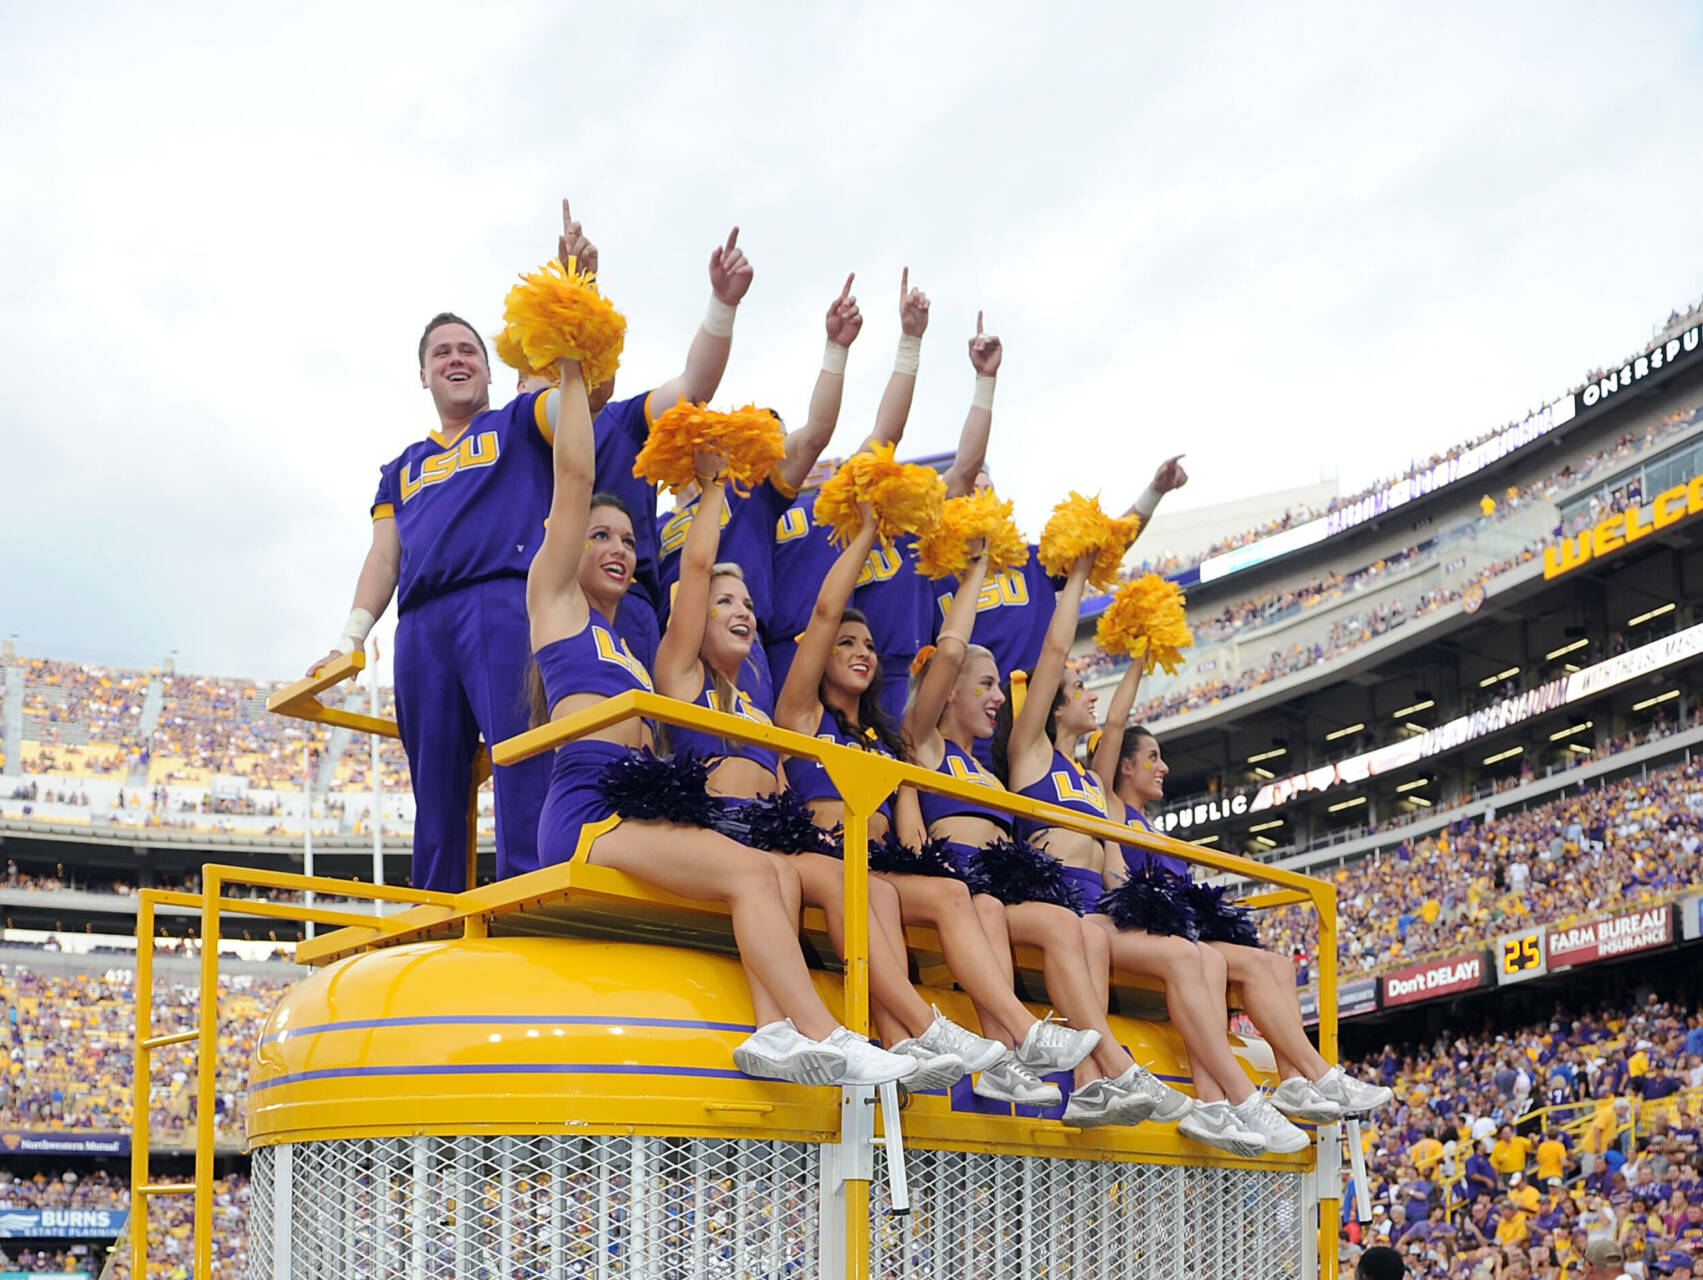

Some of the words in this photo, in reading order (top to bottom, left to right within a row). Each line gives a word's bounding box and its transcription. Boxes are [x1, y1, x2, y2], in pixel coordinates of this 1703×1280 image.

[401, 431, 500, 505] LSU
[1550, 926, 1596, 952] FARM
[1597, 907, 1667, 942] BUREAU
[1598, 927, 1666, 956] INSURANCE
[1504, 935, 1540, 974] 25
[1388, 973, 1426, 998] Don't
[1426, 959, 1480, 989] DELAY!
[24, 1227, 65, 1238] ESTATE
[68, 1228, 120, 1238] PLANNIN
[41, 1210, 111, 1228] BURNS
